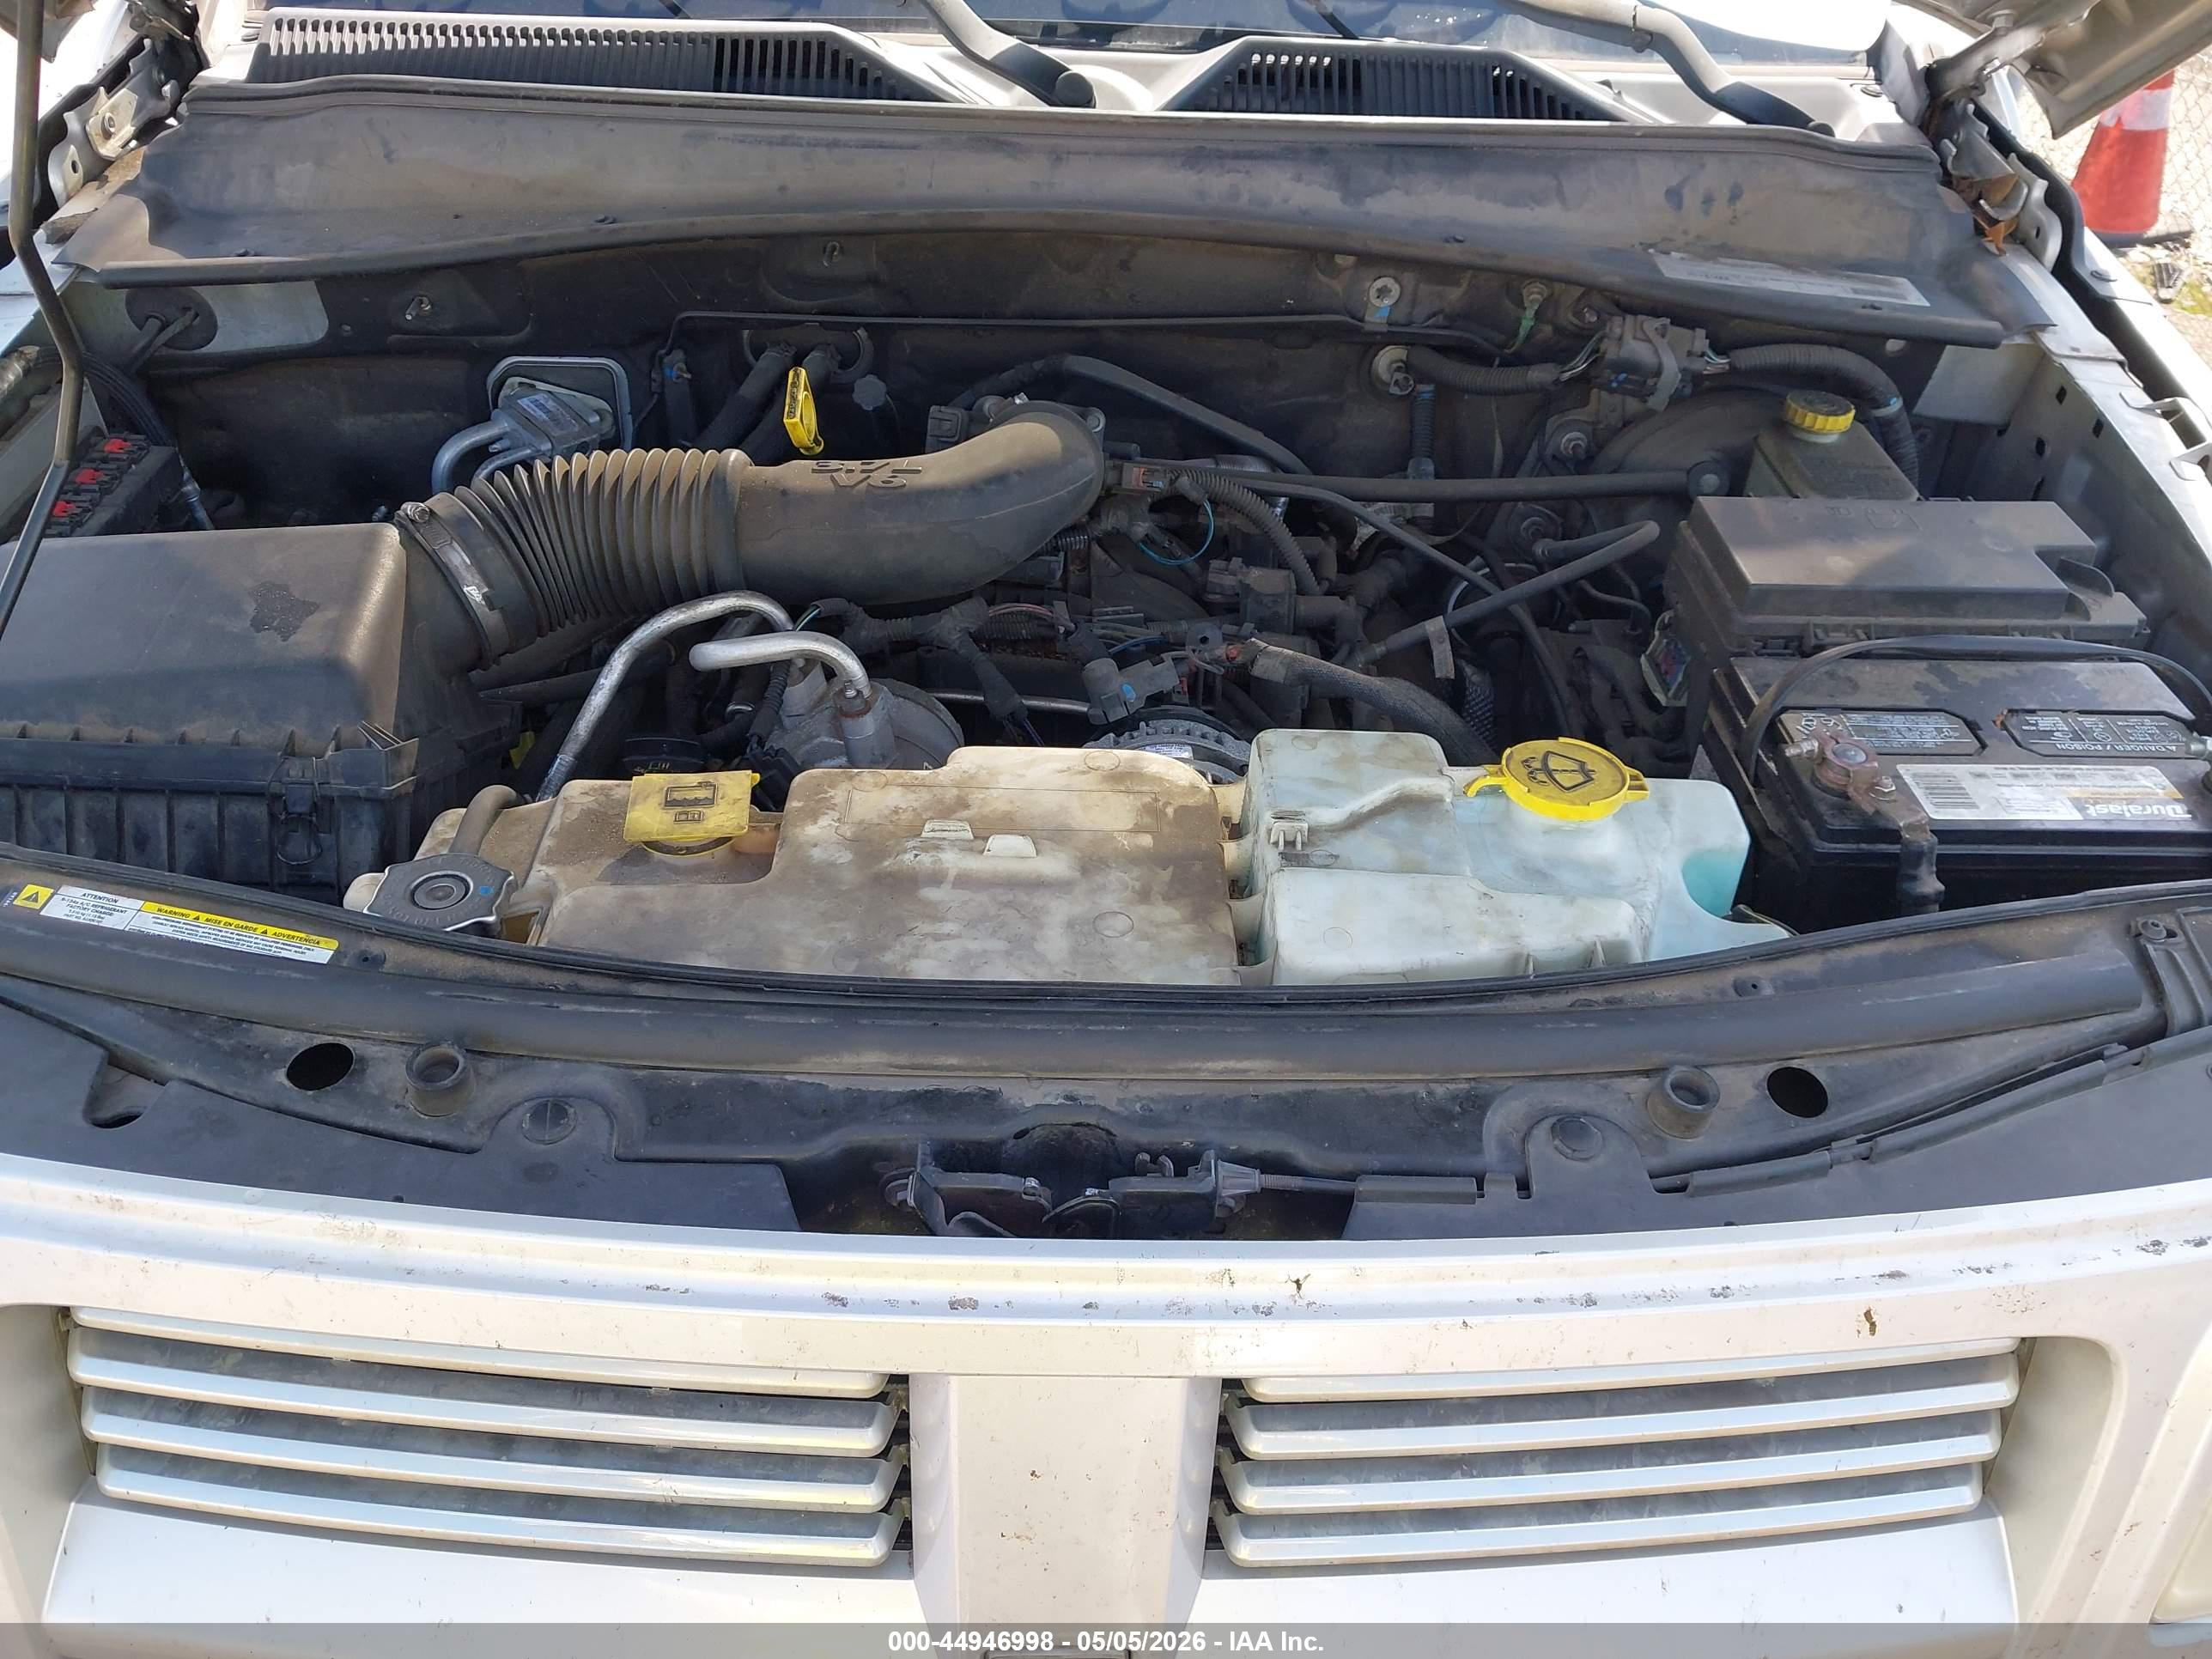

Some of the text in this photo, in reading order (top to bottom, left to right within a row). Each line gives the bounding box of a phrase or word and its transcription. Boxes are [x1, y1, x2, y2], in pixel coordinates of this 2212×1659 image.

[830, 474, 907, 489] V6
[2113, 744, 2166, 752] DANGER
[2085, 803, 2192, 819] Duralast
[82, 893, 118, 903] ATTENTION
[91, 903, 128, 915] REFRIGERANT
[156, 907, 191, 919] WARNING
[204, 917, 223, 926] MISE
[234, 922, 258, 933] GARDE
[271, 931, 320, 945] ADVERTENCIA
